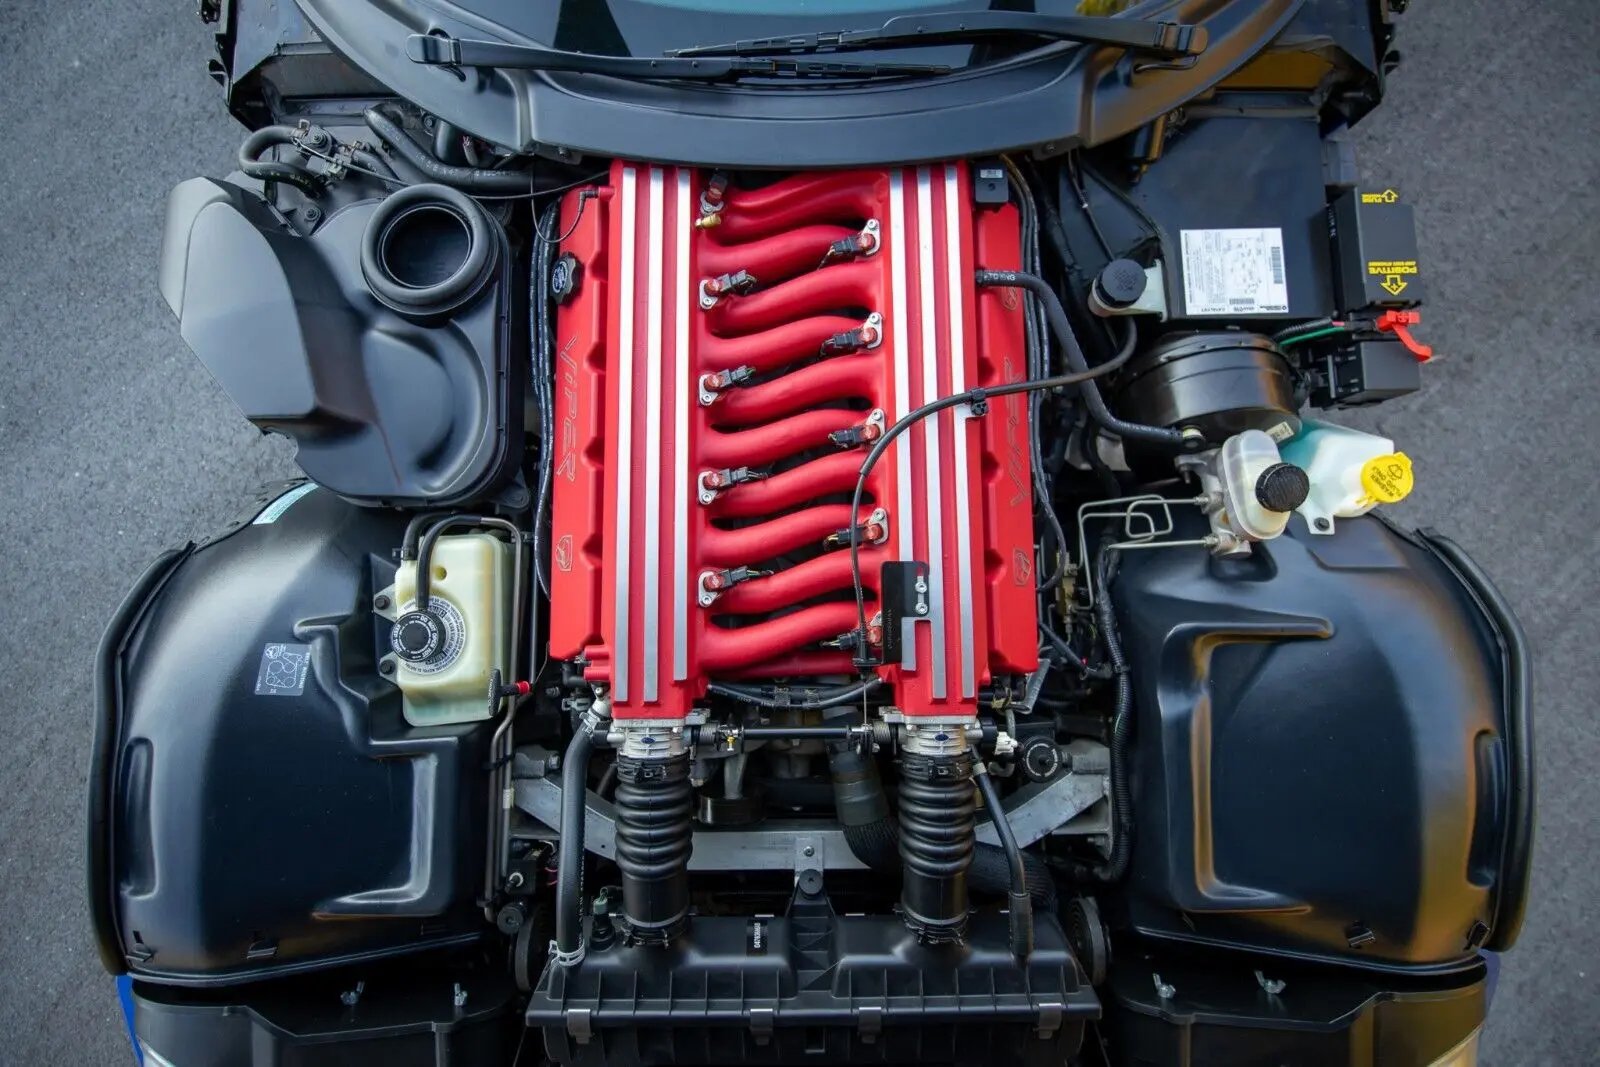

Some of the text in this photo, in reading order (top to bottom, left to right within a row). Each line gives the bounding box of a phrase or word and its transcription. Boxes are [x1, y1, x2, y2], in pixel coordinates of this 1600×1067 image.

[1368, 266, 1418, 275] POSITIVE
[1370, 474, 1394, 496] WASHER
[428, 621, 436, 630] NOT
